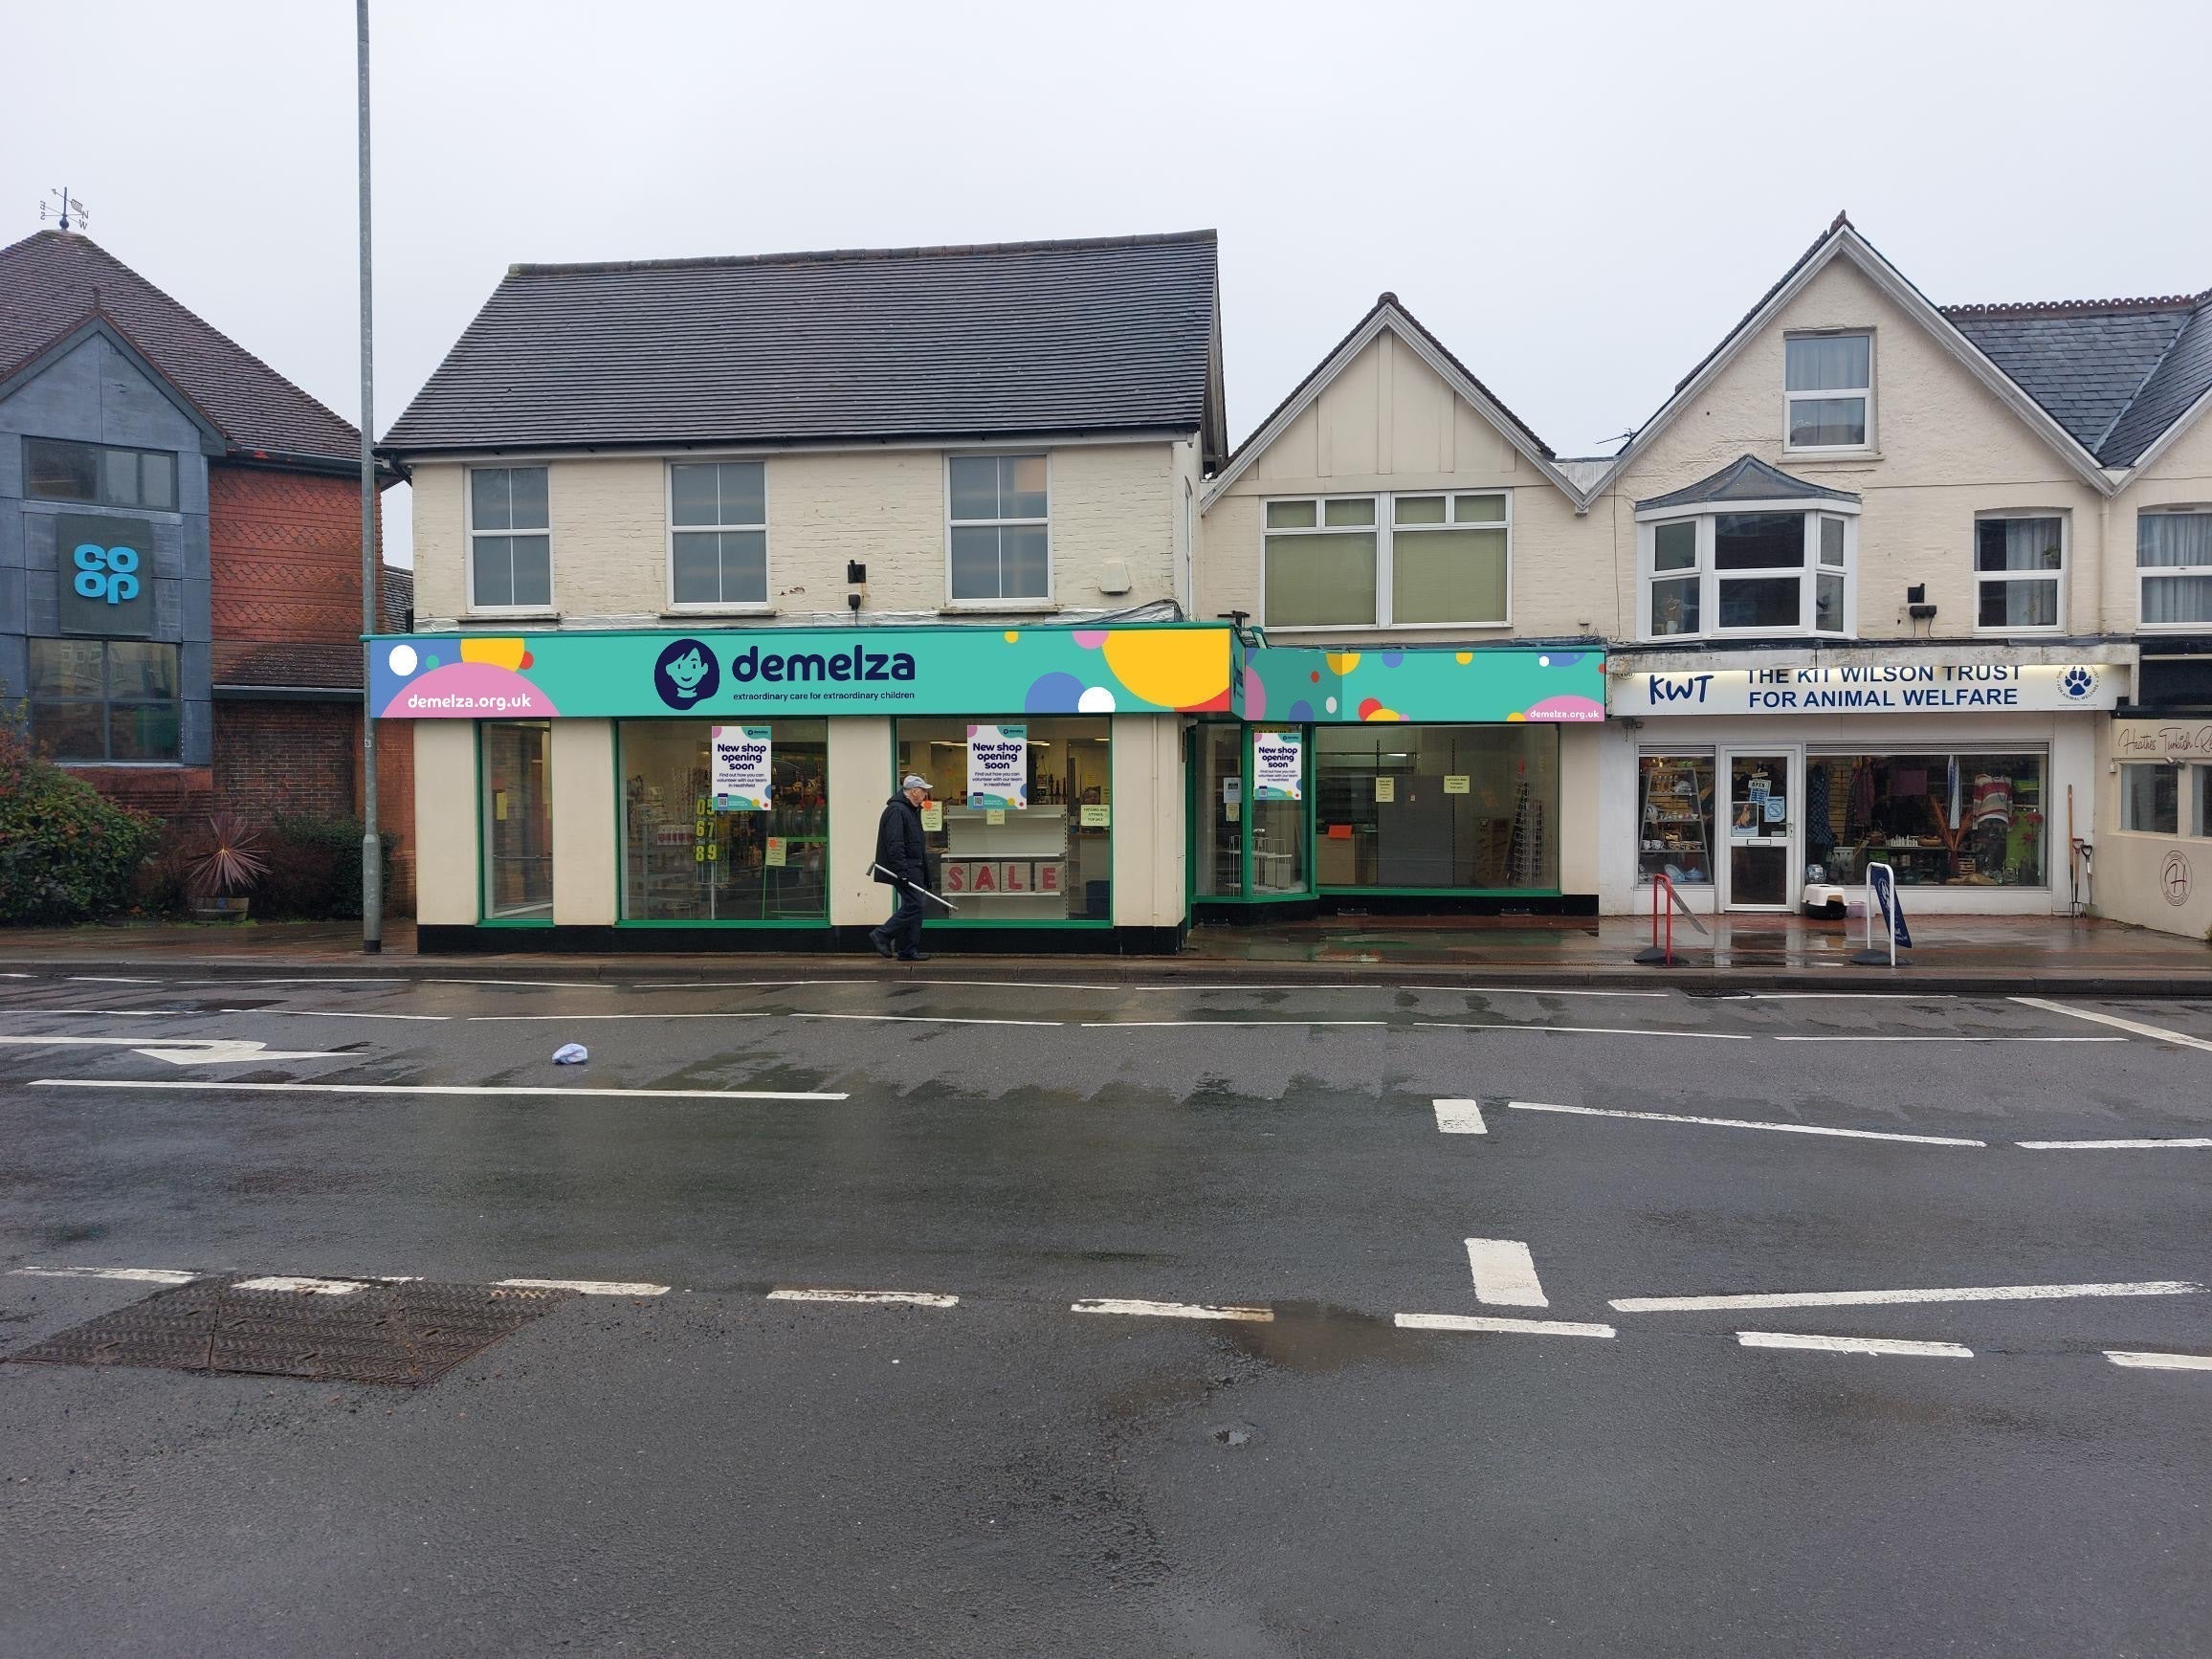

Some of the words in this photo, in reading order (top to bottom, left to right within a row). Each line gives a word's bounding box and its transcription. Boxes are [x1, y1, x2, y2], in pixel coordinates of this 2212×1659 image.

[732, 645, 916, 682] demelza
[1745, 668, 1789, 684] THE
[1840, 666, 1934, 682] WILSON
[1941, 665, 2024, 680] TRUST
[733, 691, 788, 702] extraordinary
[809, 691, 821, 700] for
[823, 690, 878, 701] extraordinary
[880, 690, 915, 699] children
[1649, 674, 1714, 706] KWT
[408, 694, 532, 711] demelza.org.uk
[1749, 691, 1798, 708] FOR
[1803, 690, 1895, 707] ANIMAL
[1902, 688, 2018, 706] WELFARE
[1530, 710, 1600, 719] demelza.org.uk
[718, 743, 740, 752] New
[741, 743, 766, 754] shop
[973, 742, 995, 751] New
[997, 742, 1022, 753] shop
[1277, 746, 1298, 755] shop
[721, 753, 763, 763] opening
[977, 752, 1017, 762] opening
[947, 865, 1057, 891] SALE
